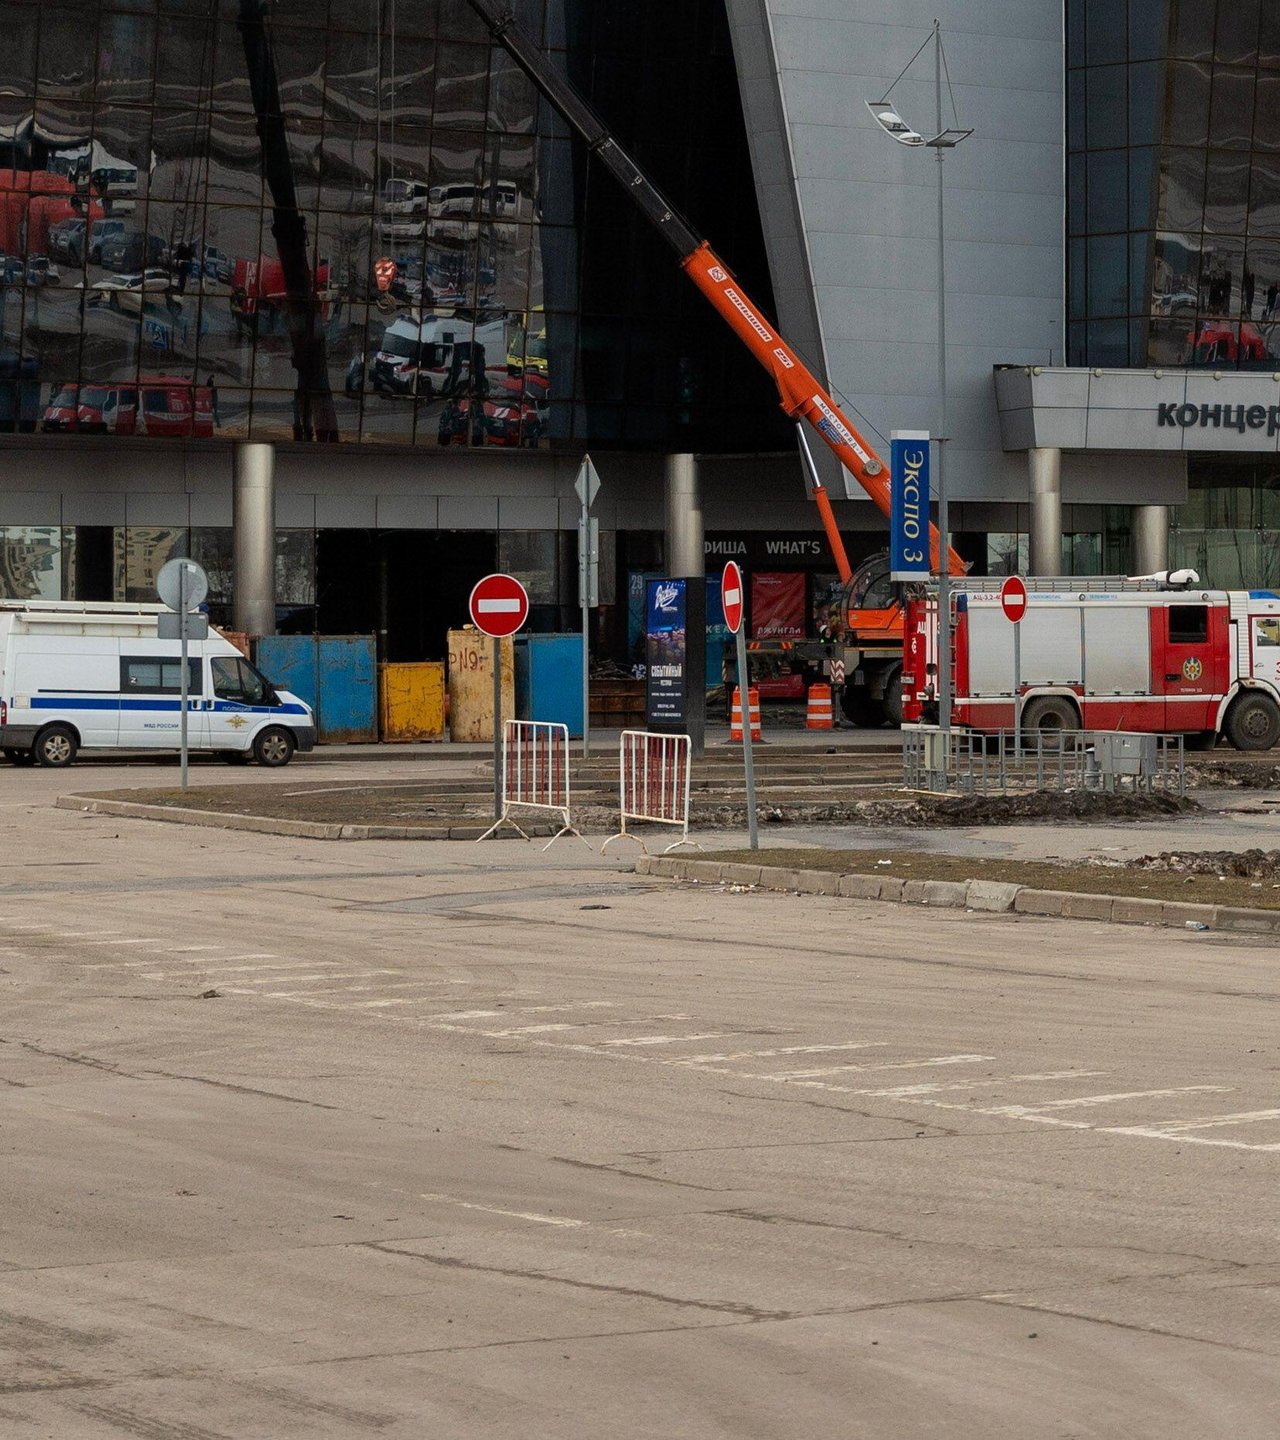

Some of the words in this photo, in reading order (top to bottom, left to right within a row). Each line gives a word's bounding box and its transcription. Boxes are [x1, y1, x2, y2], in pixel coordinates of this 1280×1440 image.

[904, 449, 924, 540] ЭКСПО
[705, 541, 747, 554] ФИША
[765, 541, 821, 554] WHAT'S
[904, 548, 924, 563] 3
